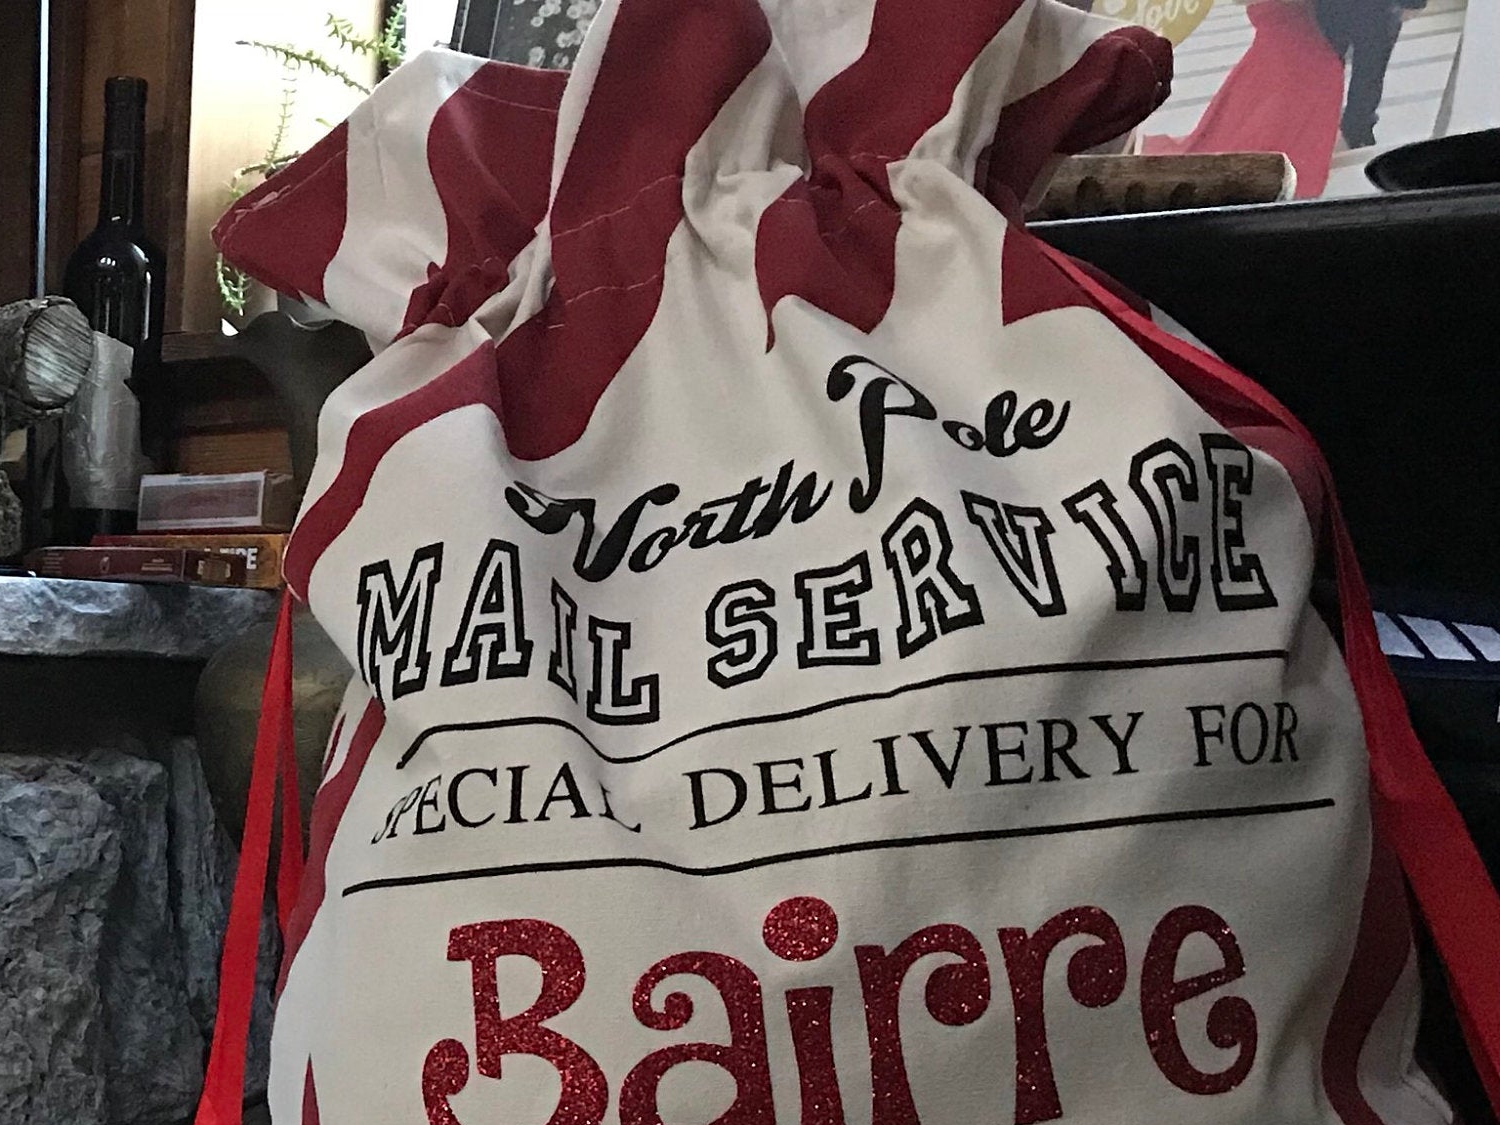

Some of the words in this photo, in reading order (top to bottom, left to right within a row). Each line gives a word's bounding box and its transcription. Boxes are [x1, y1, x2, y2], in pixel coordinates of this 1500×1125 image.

[356, 538, 660, 725] MAIL
[704, 432, 1279, 690] SERVICE
[505, 460, 833, 582] North
[826, 354, 1070, 514] Pole
[681, 711, 1145, 831] DELIVERY
[1185, 700, 1299, 768] FOR
